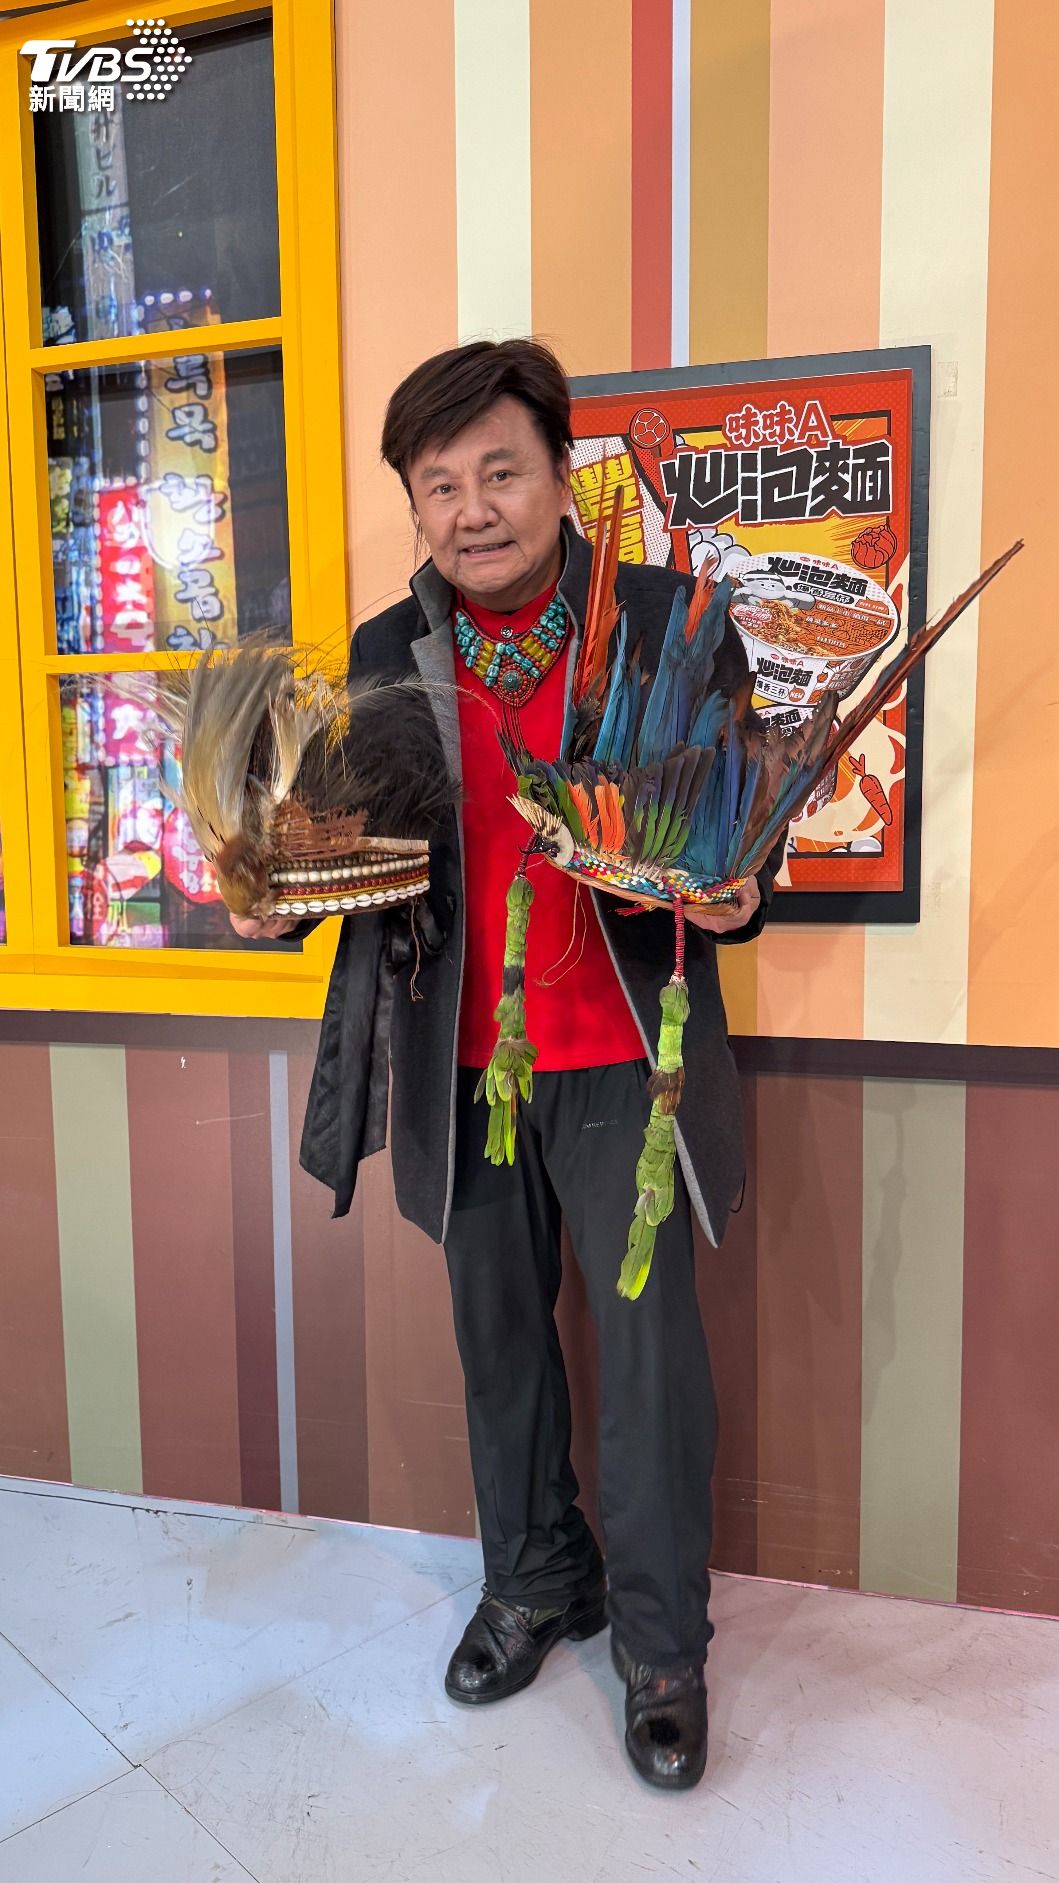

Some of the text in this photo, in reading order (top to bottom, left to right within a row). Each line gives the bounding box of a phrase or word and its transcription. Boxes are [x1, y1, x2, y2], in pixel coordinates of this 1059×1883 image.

[726, 401, 832, 446] 味味A
[660, 439, 892, 529] 炒泡麵
[768, 556, 868, 597] 炒泡麵
[757, 657, 814, 687] 炒泡麵
[789, 690, 805, 700] NEW
